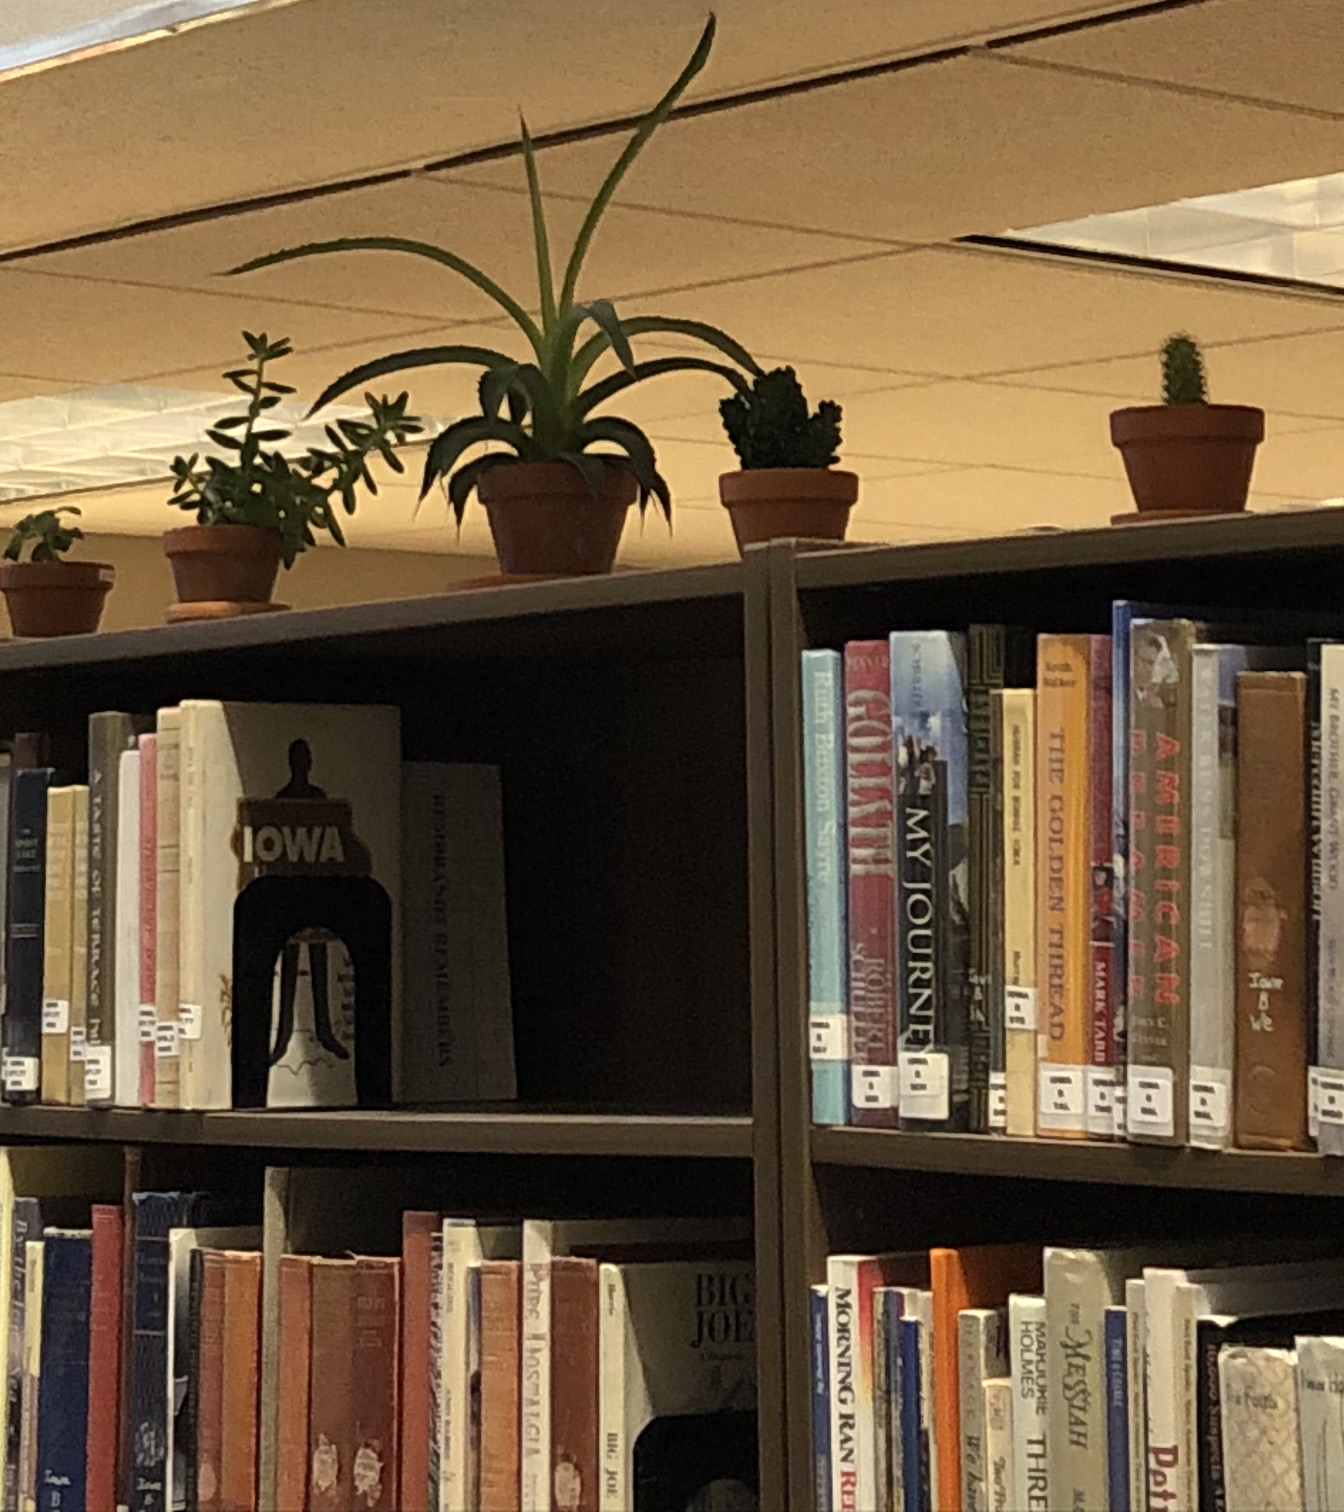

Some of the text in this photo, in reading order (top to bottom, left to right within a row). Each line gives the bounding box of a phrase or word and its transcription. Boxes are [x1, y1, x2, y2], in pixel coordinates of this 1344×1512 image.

[92, 768, 105, 784] A
[812, 669, 836, 882] Ruth Buxton Sayre
[847, 688, 894, 881] GOLIATH
[91, 793, 105, 860] TASTE
[243, 824, 345, 863] IOWA
[904, 806, 933, 870] MY
[90, 868, 104, 899] OF
[1047, 727, 1068, 1042] THE GOLDEN THREAD
[1154, 732, 1182, 1005] AMERICAN
[88, 906, 104, 1007] TERRACE
[1094, 961, 1108, 1013] MARK
[866, 958, 887, 1050] ROBERT
[1094, 1019, 1108, 1063] TABB
[696, 1272, 753, 1307] BIG
[689, 1308, 755, 1348] JOE
[836, 1286, 856, 1406] MORNING
[1020, 1321, 1035, 1399] HOLMES
[1059, 1325, 1093, 1452] MESSIAH
[605, 1431, 619, 1499] BIG JOE
[838, 1411, 856, 1464] RAN
[1026, 1431, 1050, 1512] THRE
